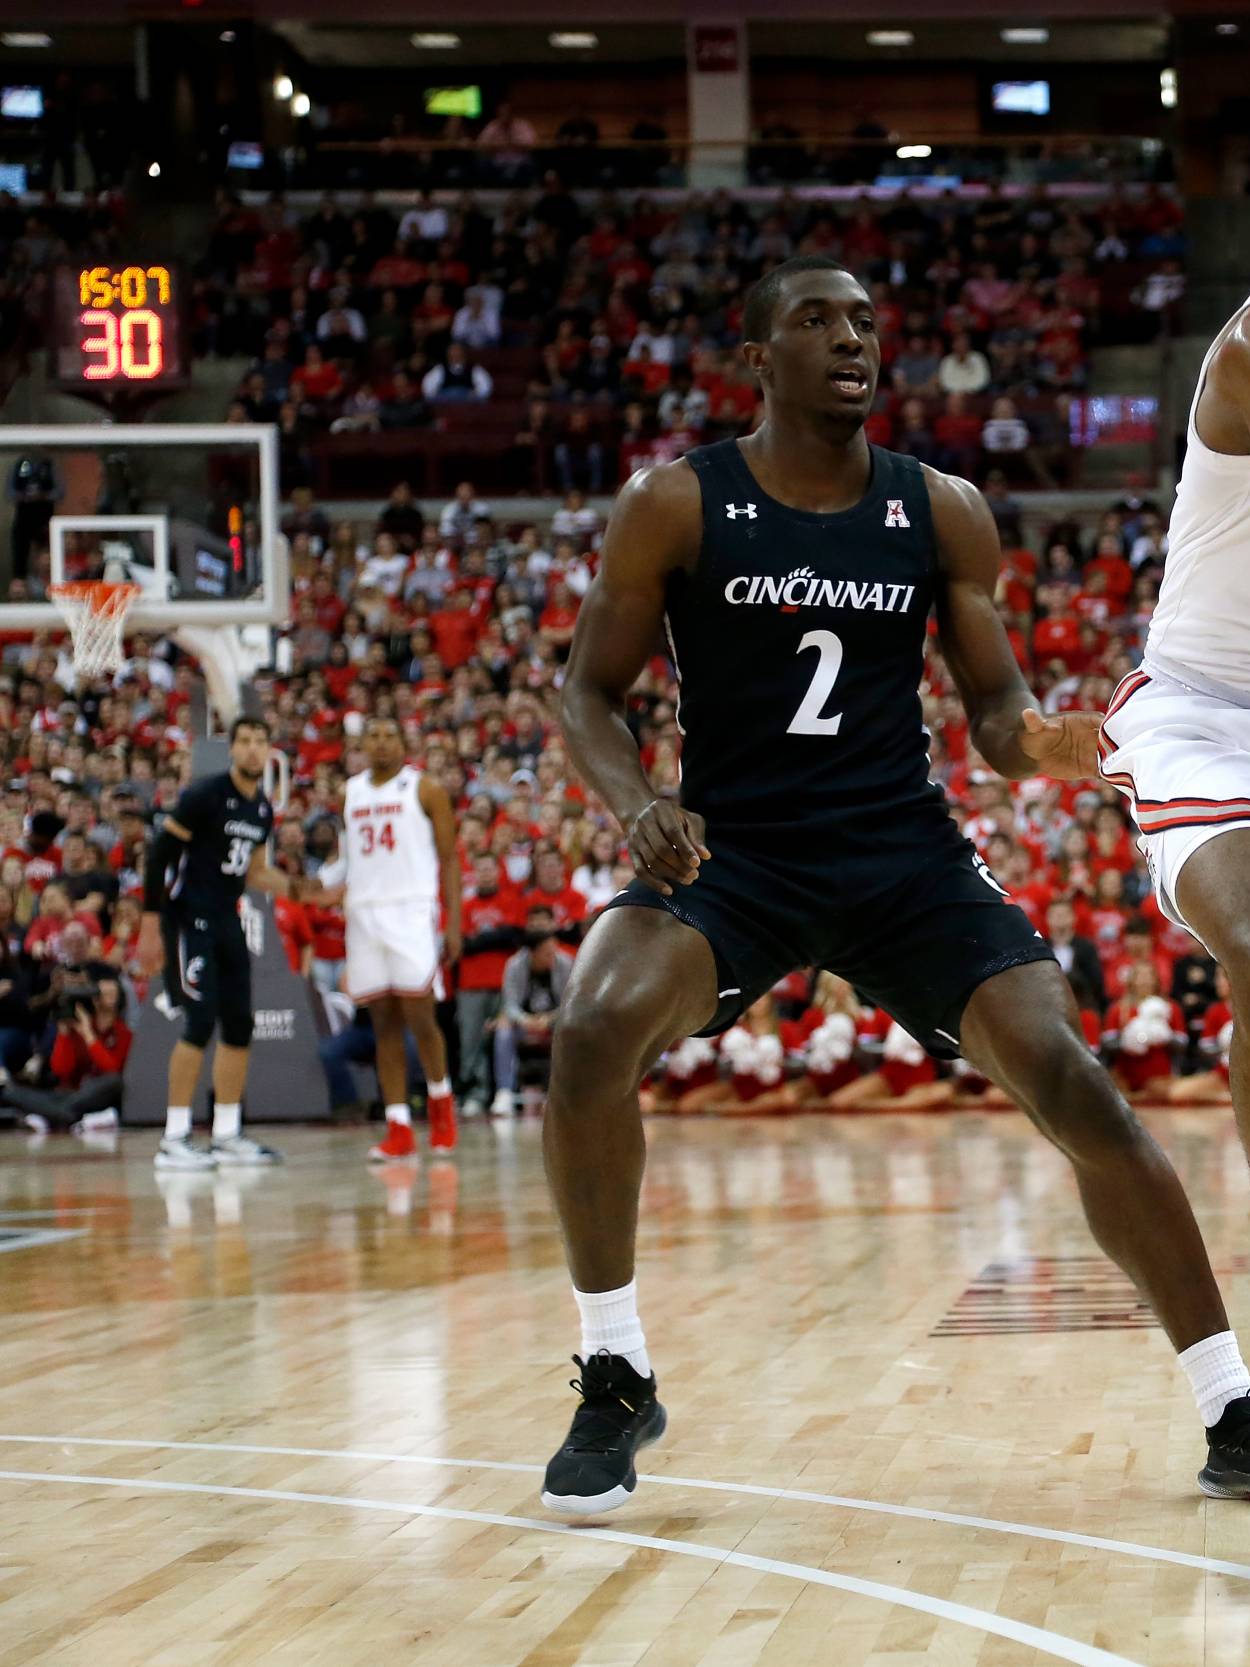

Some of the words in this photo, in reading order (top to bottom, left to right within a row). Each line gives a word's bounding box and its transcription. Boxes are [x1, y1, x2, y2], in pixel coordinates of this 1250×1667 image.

[80, 266, 170, 308] 15:07
[81, 310, 162, 379] 30
[724, 570, 916, 613] CINCINNATI
[786, 629, 844, 736] 2
[360, 823, 397, 856] 34
